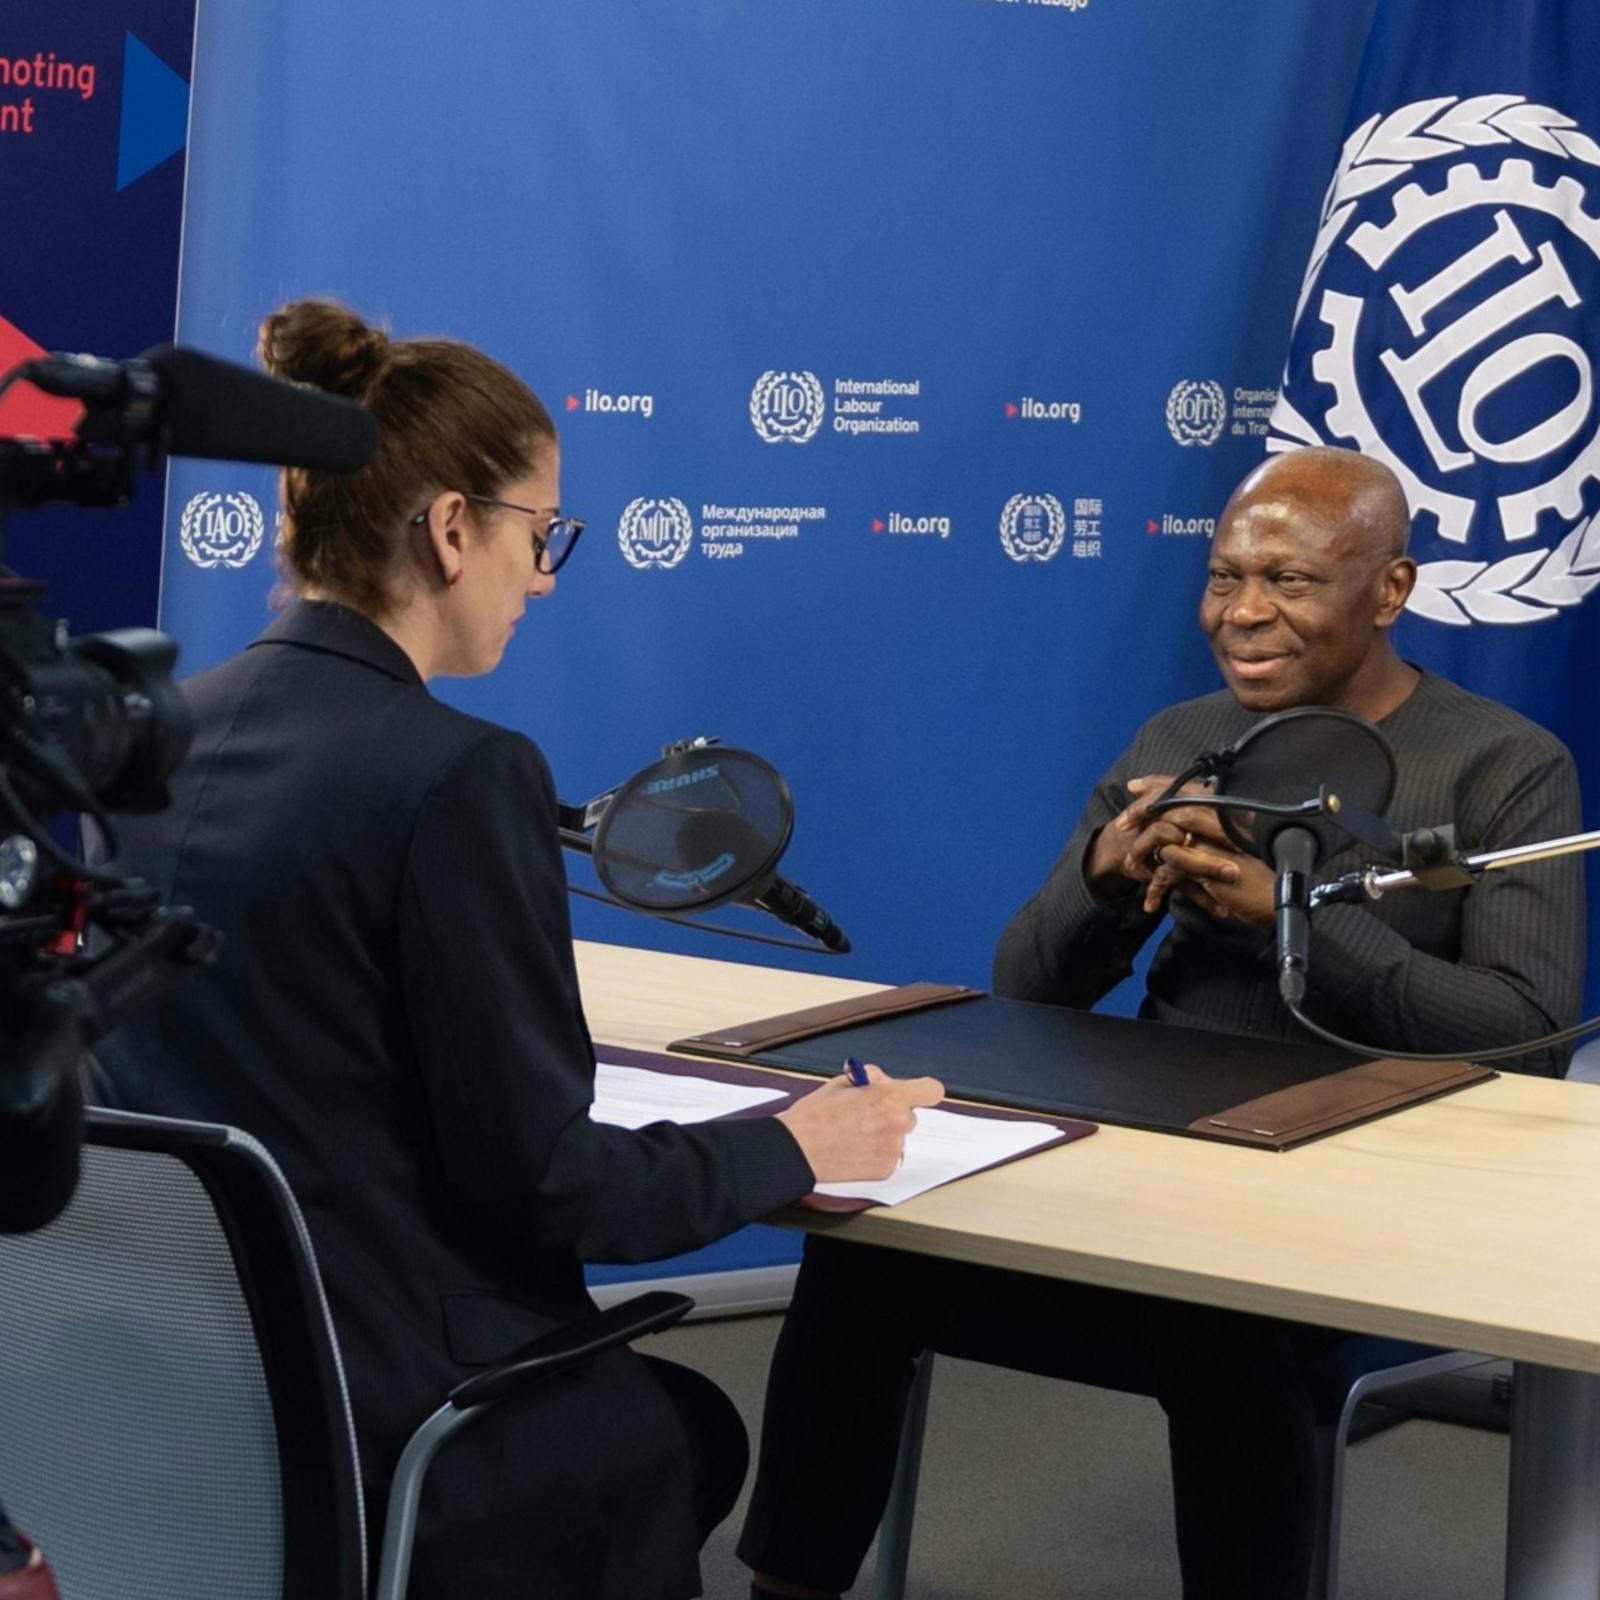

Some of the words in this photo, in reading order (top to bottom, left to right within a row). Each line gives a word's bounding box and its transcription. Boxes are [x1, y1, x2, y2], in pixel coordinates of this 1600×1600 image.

[1379, 209, 1592, 472] ILO
[835, 378, 920, 395] International
[585, 389, 653, 417] ilo.org
[772, 384, 805, 420] ILO
[834, 398, 882, 413] Labour
[1021, 397, 1081, 424] ilo.org
[833, 416, 920, 435] Organization
[702, 504, 826, 522] Международная
[1074, 498, 1103, 516] 国际
[204, 506, 242, 543] IAO
[701, 523, 798, 540] организация
[888, 512, 950, 538] ilo.org
[1073, 519, 1101, 537] 劳工
[1162, 514, 1215, 538] ilo.org
[701, 543, 744, 559] труда
